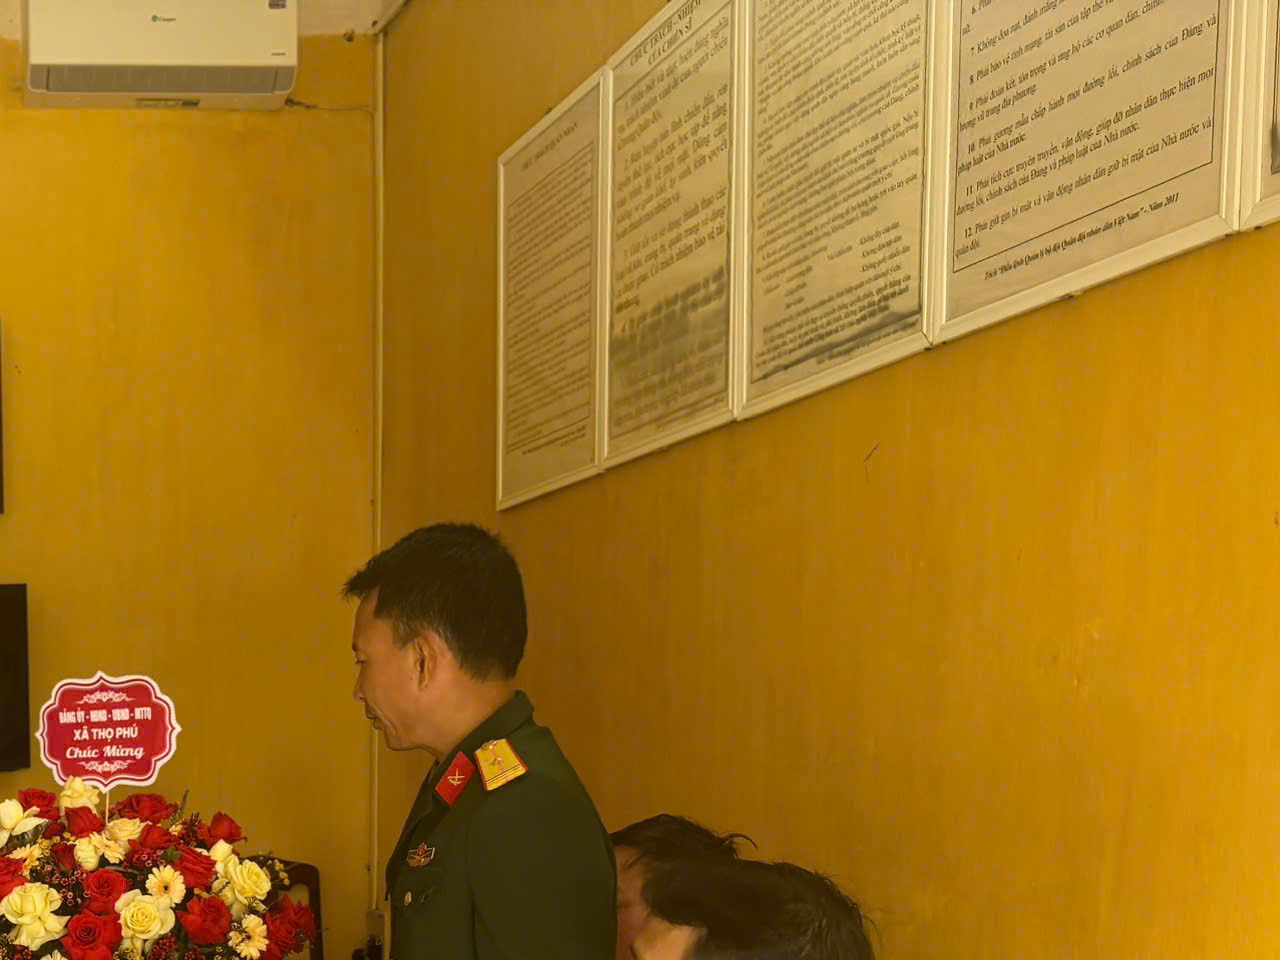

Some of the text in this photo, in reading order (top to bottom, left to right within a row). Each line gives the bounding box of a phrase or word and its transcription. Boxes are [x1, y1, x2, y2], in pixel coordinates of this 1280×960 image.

[73, 723, 138, 742] XÃ THỌ PHÚ
[66, 746, 99, 759] Chúc
